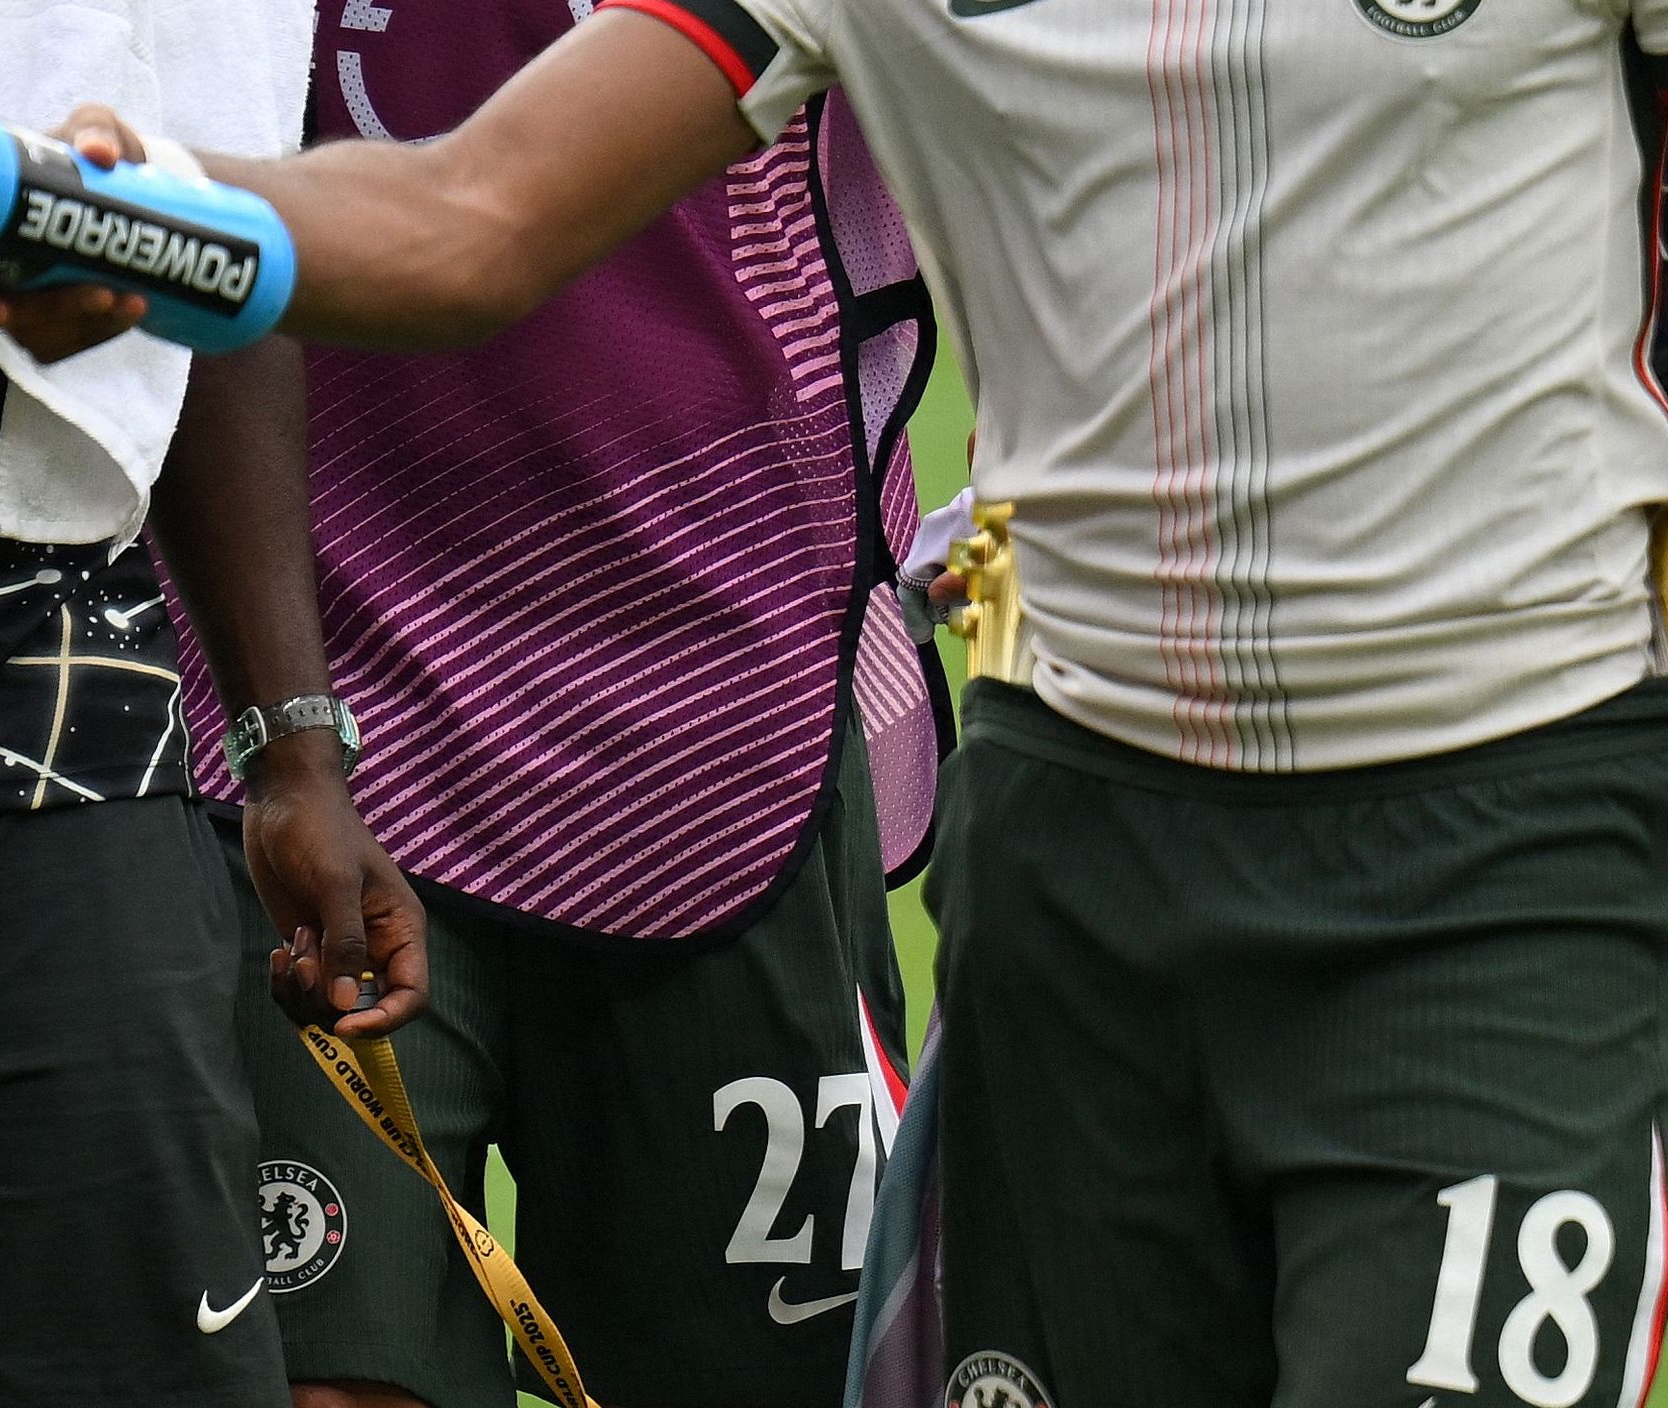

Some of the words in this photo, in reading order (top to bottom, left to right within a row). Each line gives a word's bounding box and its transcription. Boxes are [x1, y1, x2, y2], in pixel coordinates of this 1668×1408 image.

[18, 191, 259, 303] POWERADE
[308, 1031, 338, 1061] CUP
[335, 1060, 384, 1118] WORLD
[261, 1166, 318, 1192] ELSEA
[713, 1075, 876, 1271] 27
[298, 1258, 325, 1280] CLUB
[1406, 1174, 1616, 1408] 18
[536, 1345, 560, 1375] CUP
[958, 1359, 1026, 1391] CHELSEA
